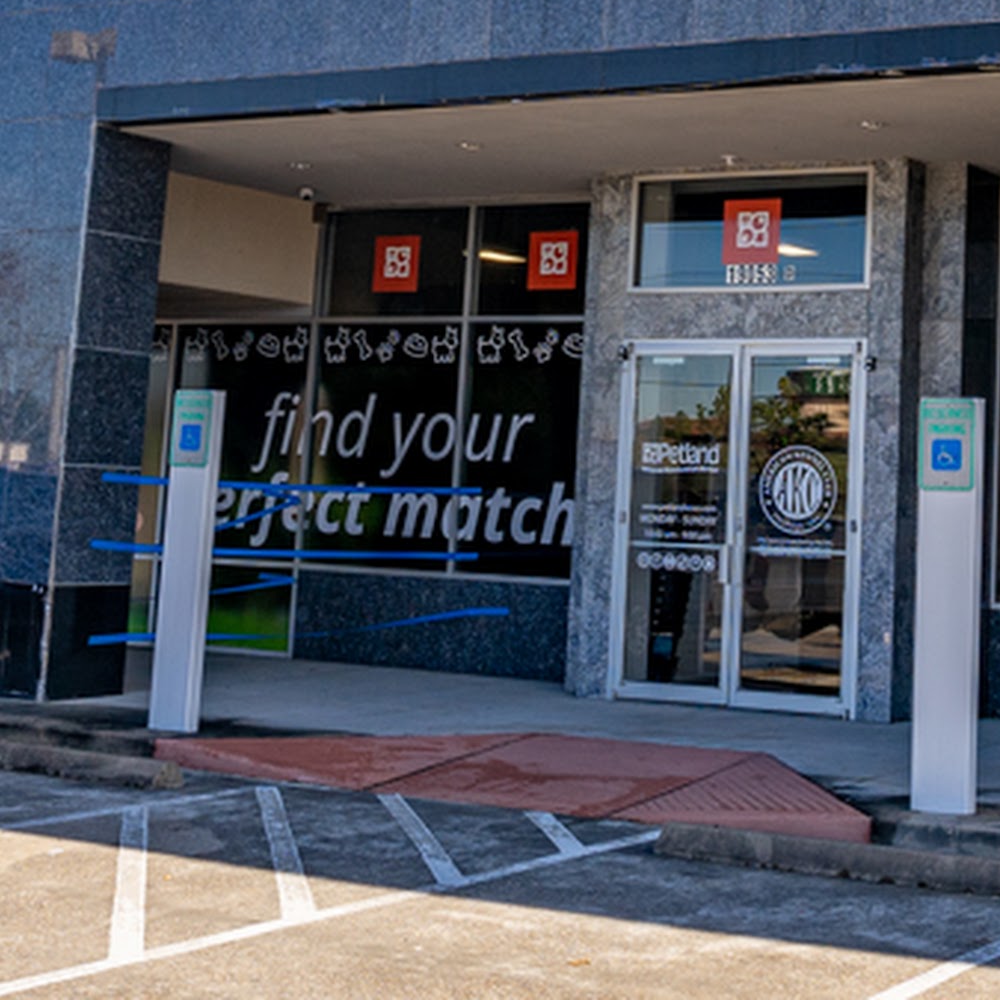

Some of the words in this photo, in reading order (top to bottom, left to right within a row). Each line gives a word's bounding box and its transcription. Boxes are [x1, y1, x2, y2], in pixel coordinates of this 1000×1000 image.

[251, 392, 377, 473] find
[379, 411, 536, 479] your
[660, 442, 720, 465] Petland
[213, 472, 371, 548] erfect
[383, 482, 576, 547] match
